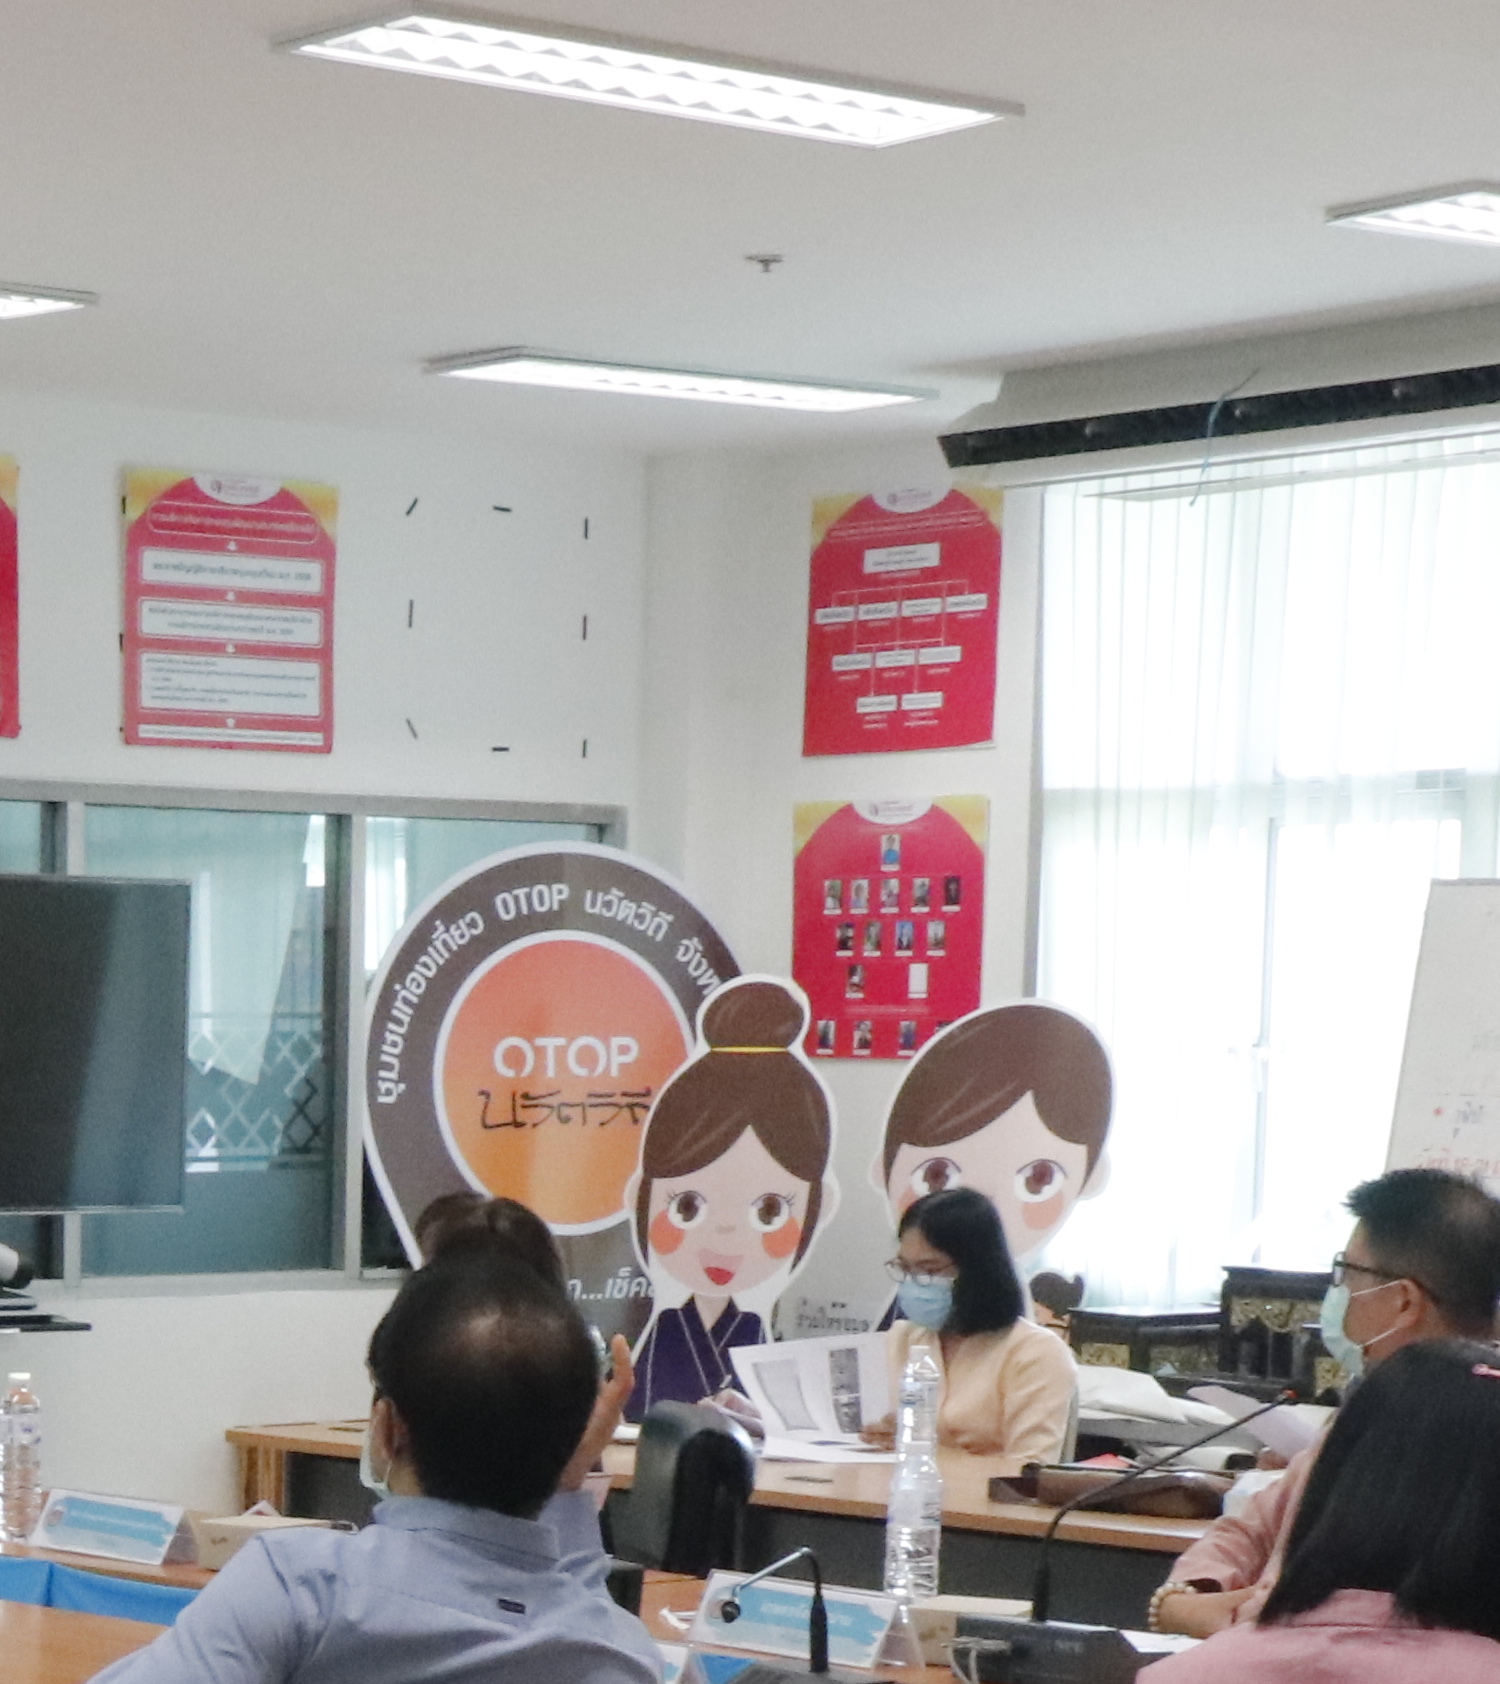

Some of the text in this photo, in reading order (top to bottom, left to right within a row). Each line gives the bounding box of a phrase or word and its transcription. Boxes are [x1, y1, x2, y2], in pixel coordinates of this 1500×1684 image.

[377, 911, 486, 1104] ชุมชนท่องเที่ยว
[494, 883, 570, 923] OTOP
[583, 886, 674, 944] นวัตวิถี
[493, 1035, 640, 1079] OTOP
